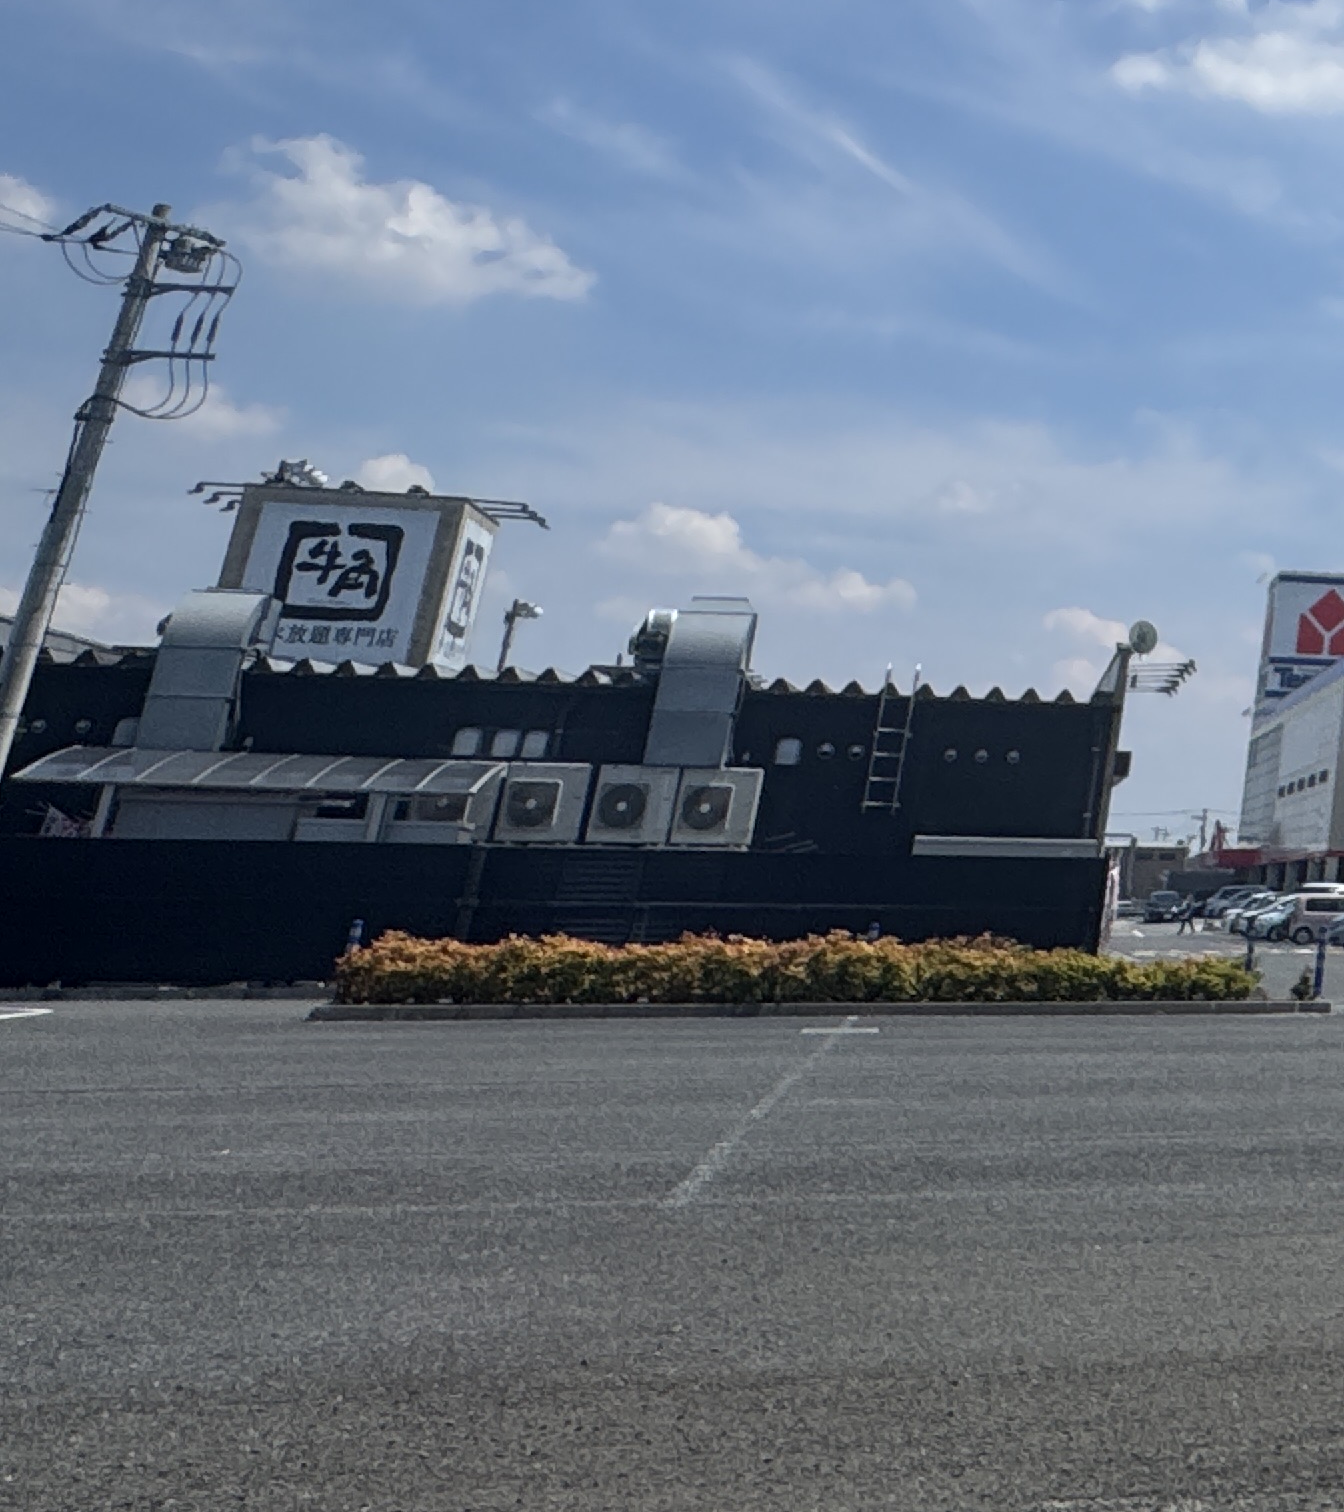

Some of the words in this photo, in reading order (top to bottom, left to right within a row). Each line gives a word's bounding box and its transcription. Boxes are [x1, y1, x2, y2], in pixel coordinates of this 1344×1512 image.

[296, 539, 379, 598] 牛角
[277, 623, 400, 648] 放題専門店
